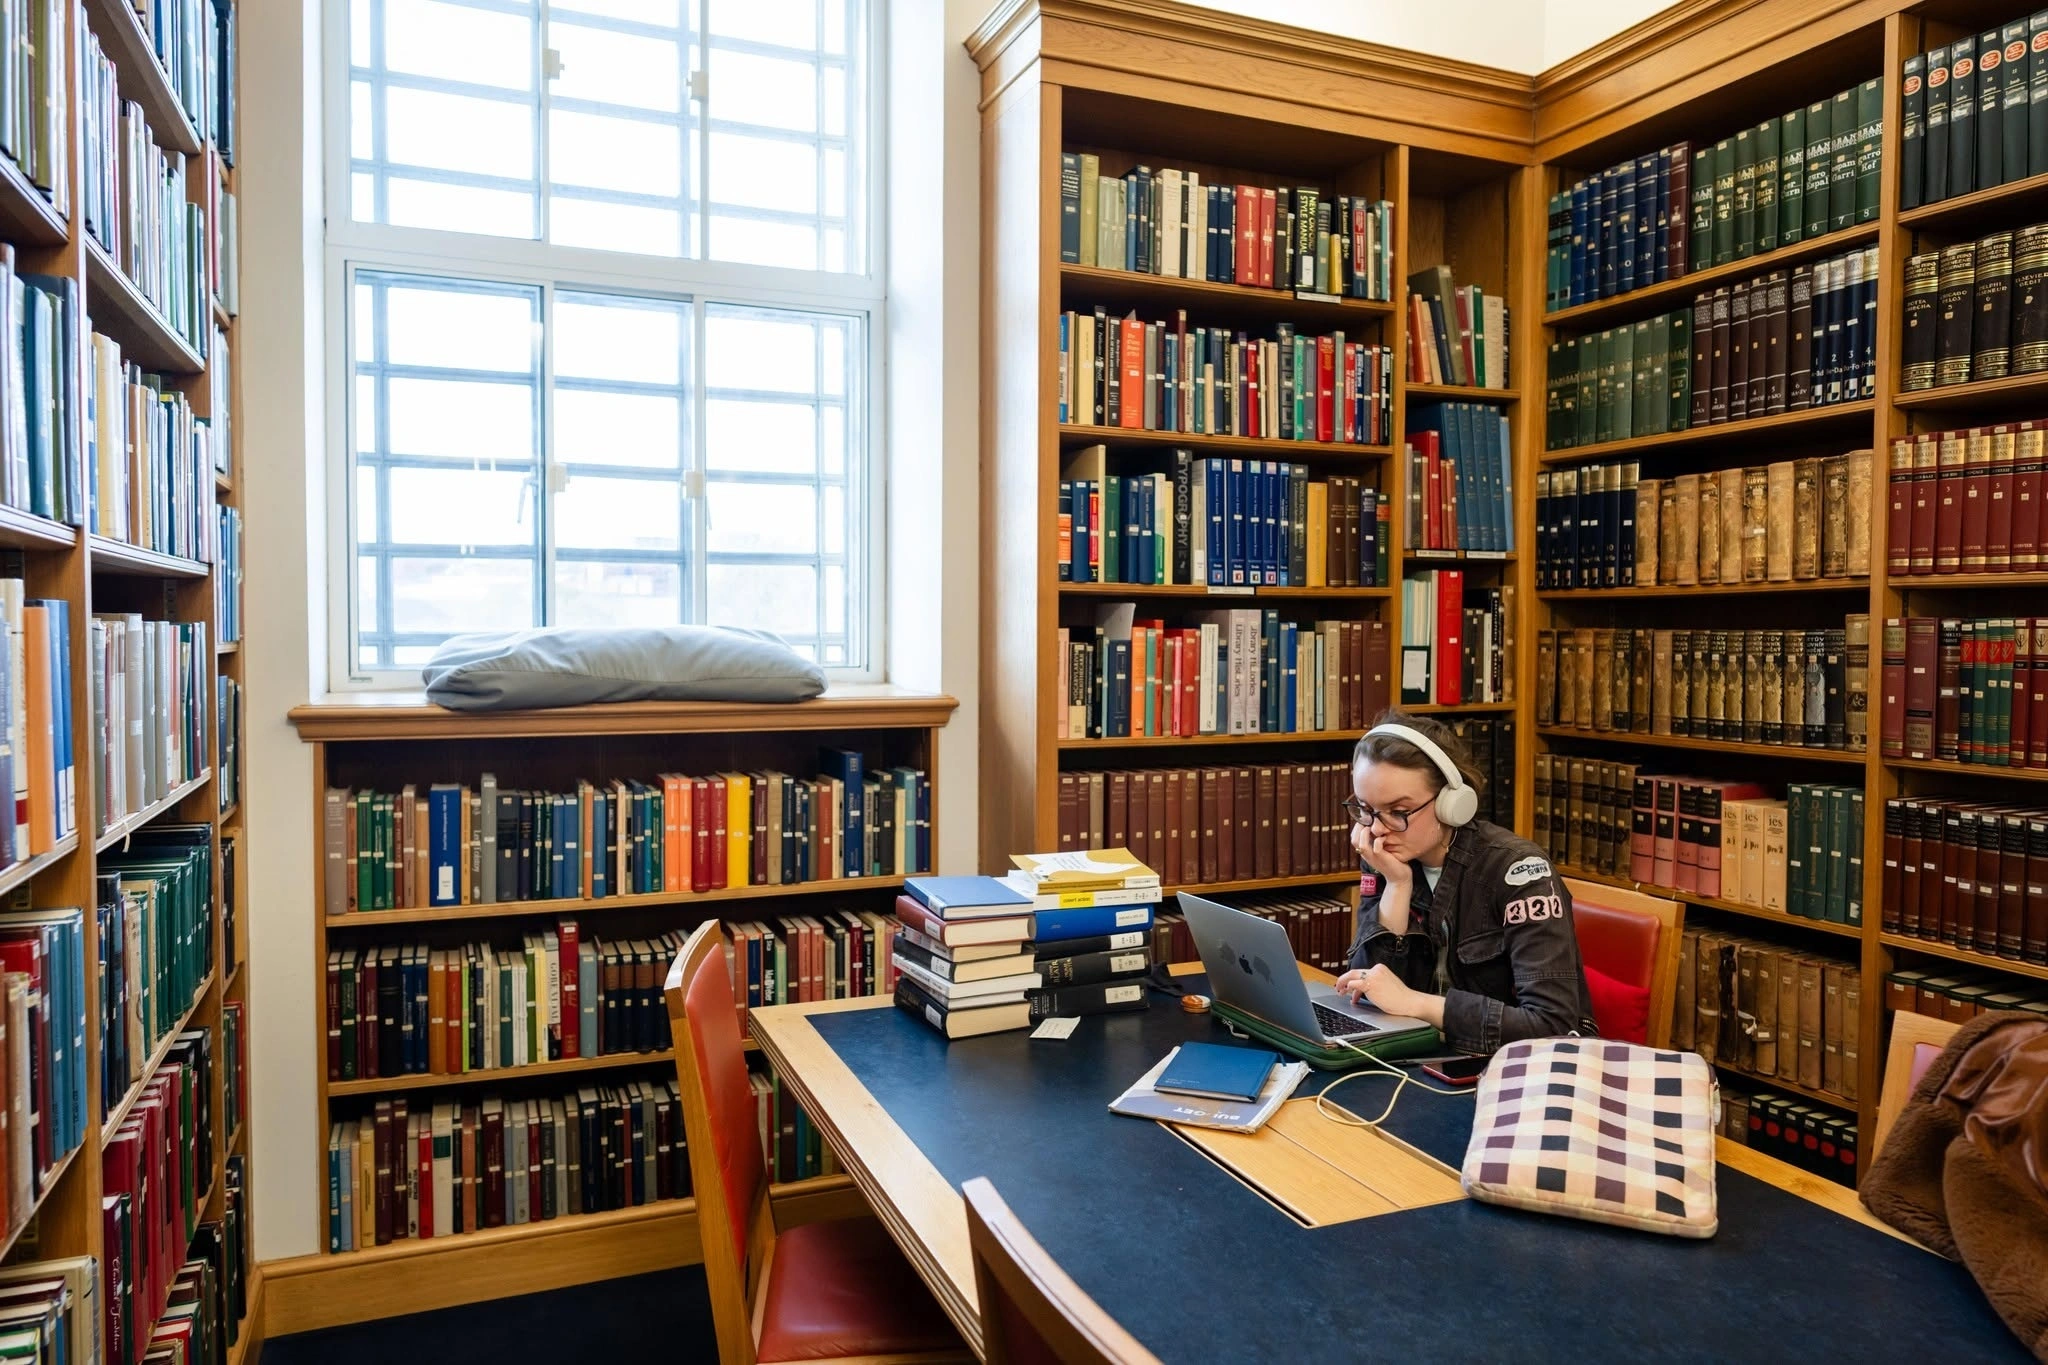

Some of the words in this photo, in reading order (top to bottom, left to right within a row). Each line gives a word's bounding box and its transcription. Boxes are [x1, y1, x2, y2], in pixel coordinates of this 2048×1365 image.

[1300, 195, 1308, 218] STYLE
[1308, 196, 1316, 215] NEW
[1863, 208, 1870, 217] 8
[1838, 216, 1845, 225] 7
[1811, 223, 1818, 232] 6
[1299, 220, 1307, 254] MANUAL
[1785, 231, 1791, 240] 5
[1760, 238, 1766, 247] 4
[1848, 350, 1854, 359] 3
[1865, 346, 1871, 355] 4
[1831, 353, 1837, 362] 2
[1233, 624, 1243, 656] Library
[1248, 626, 1258, 654] ibrary
[1235, 658, 1243, 697] Histries
[550, 962, 559, 990] GORE
[1173, 1107, 1240, 1120] BUGET
